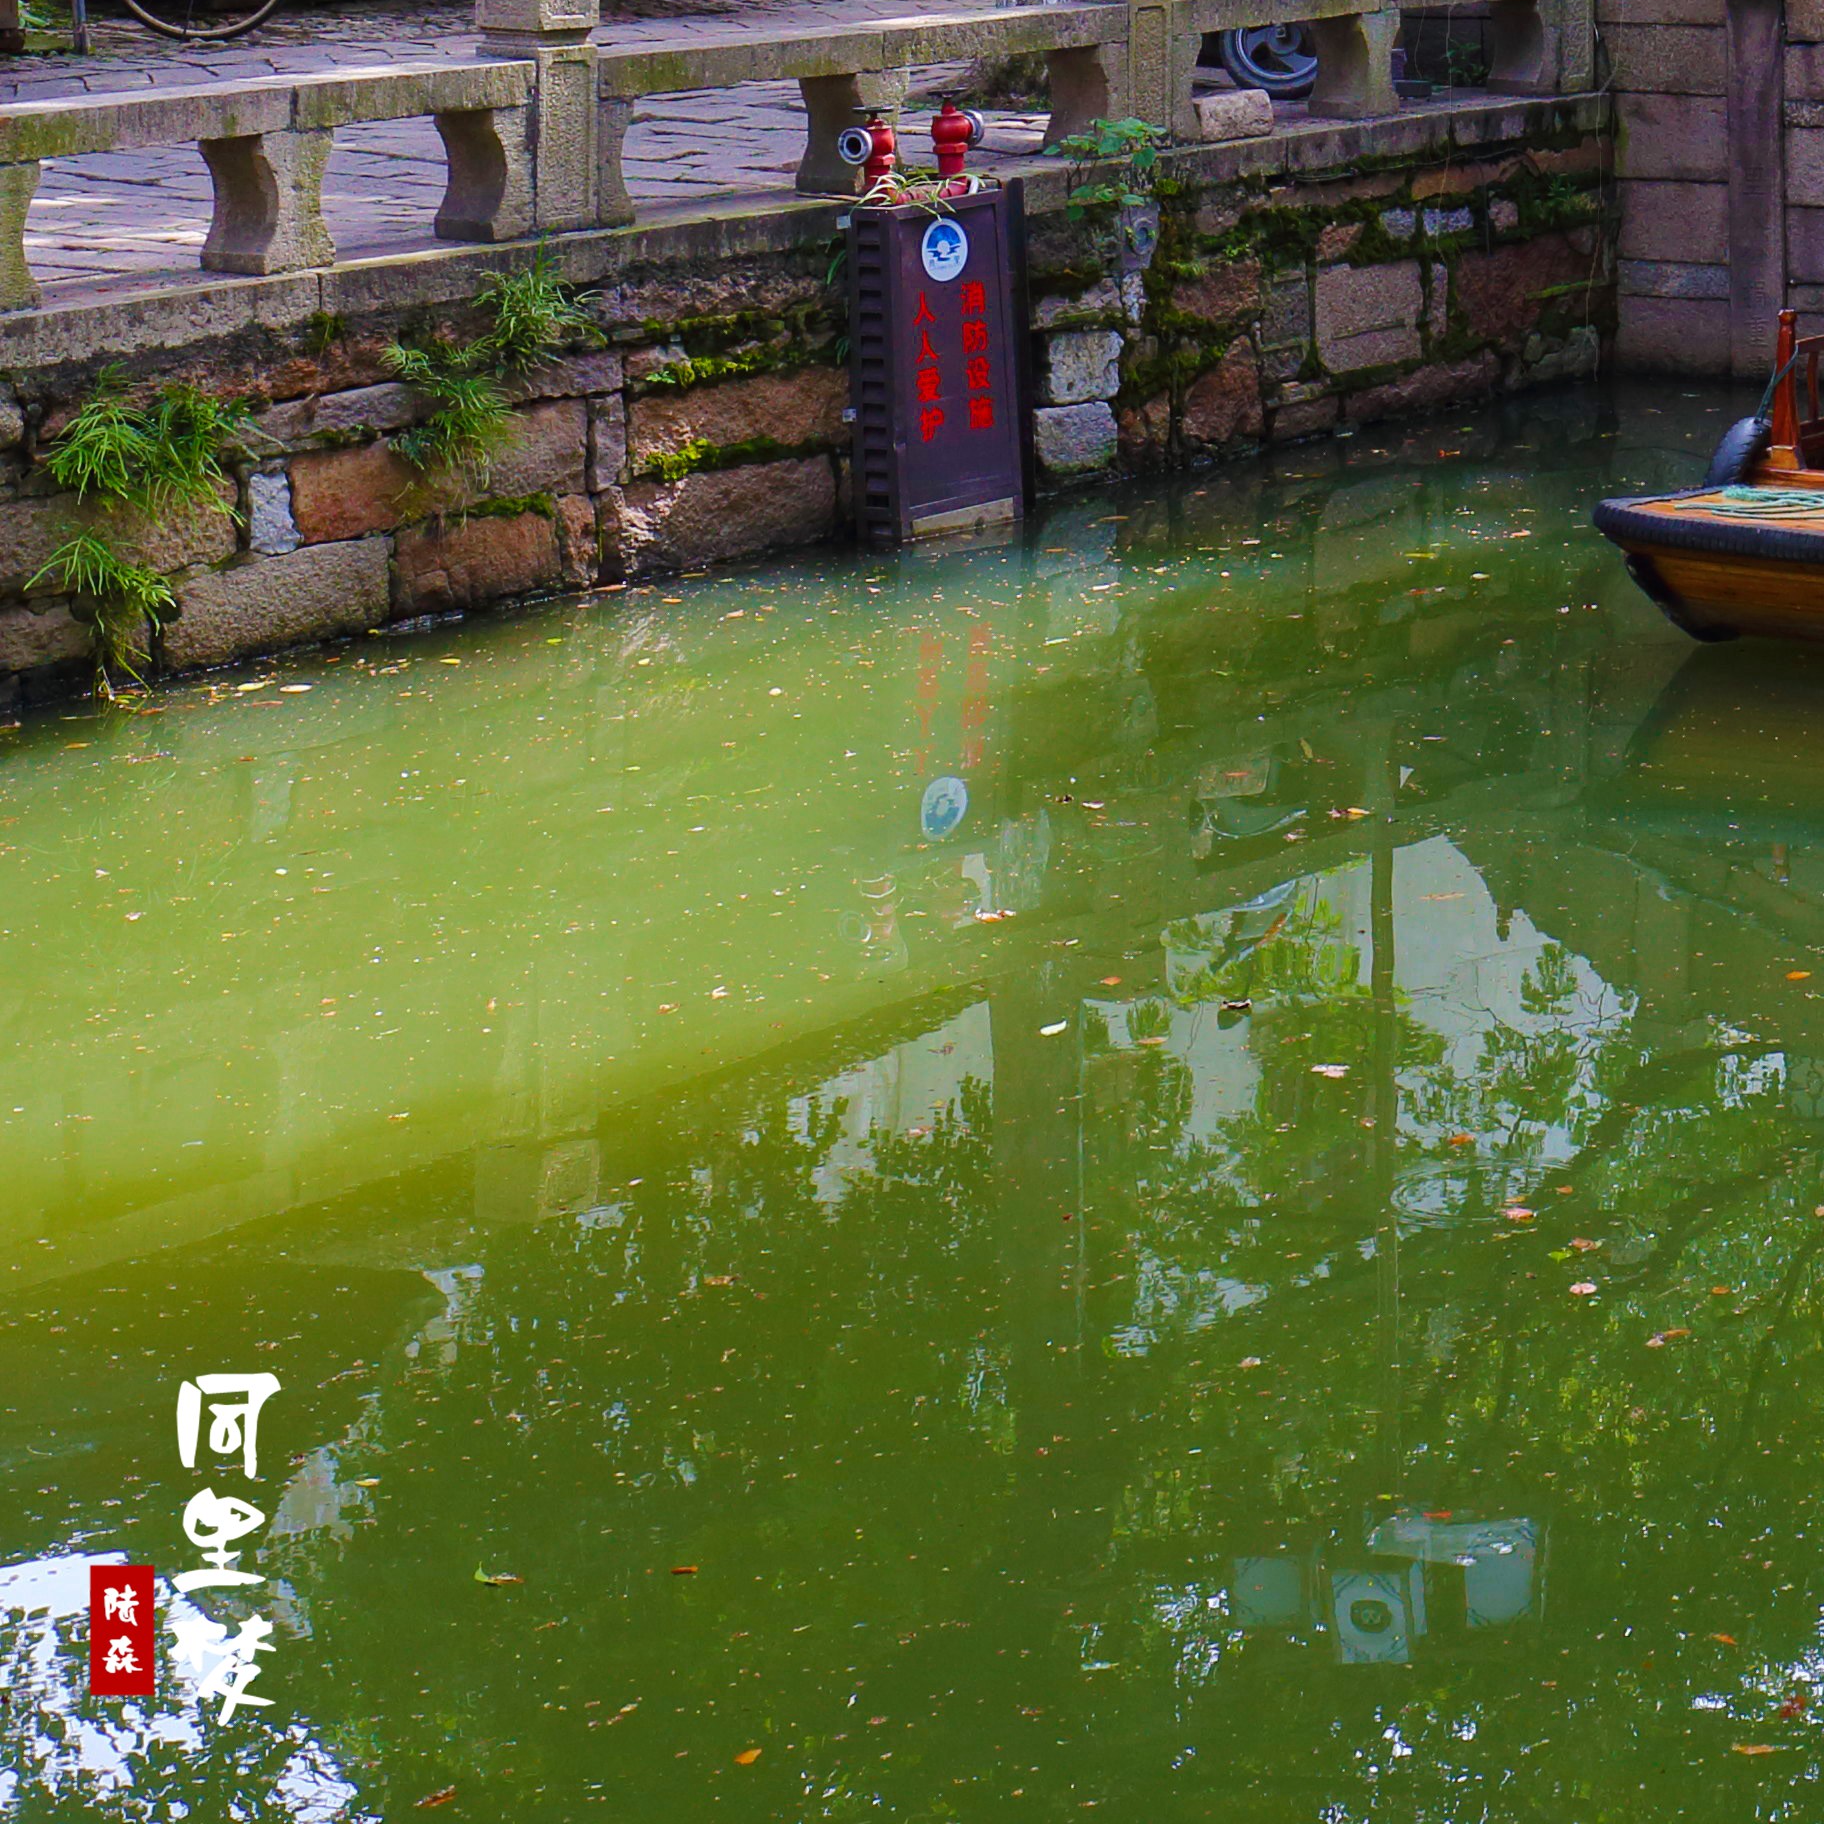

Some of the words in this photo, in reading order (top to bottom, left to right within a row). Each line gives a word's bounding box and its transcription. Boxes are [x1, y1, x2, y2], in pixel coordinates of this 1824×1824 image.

[913, 290, 945, 443] 人人爱护
[960, 280, 994, 431] 消防设施
